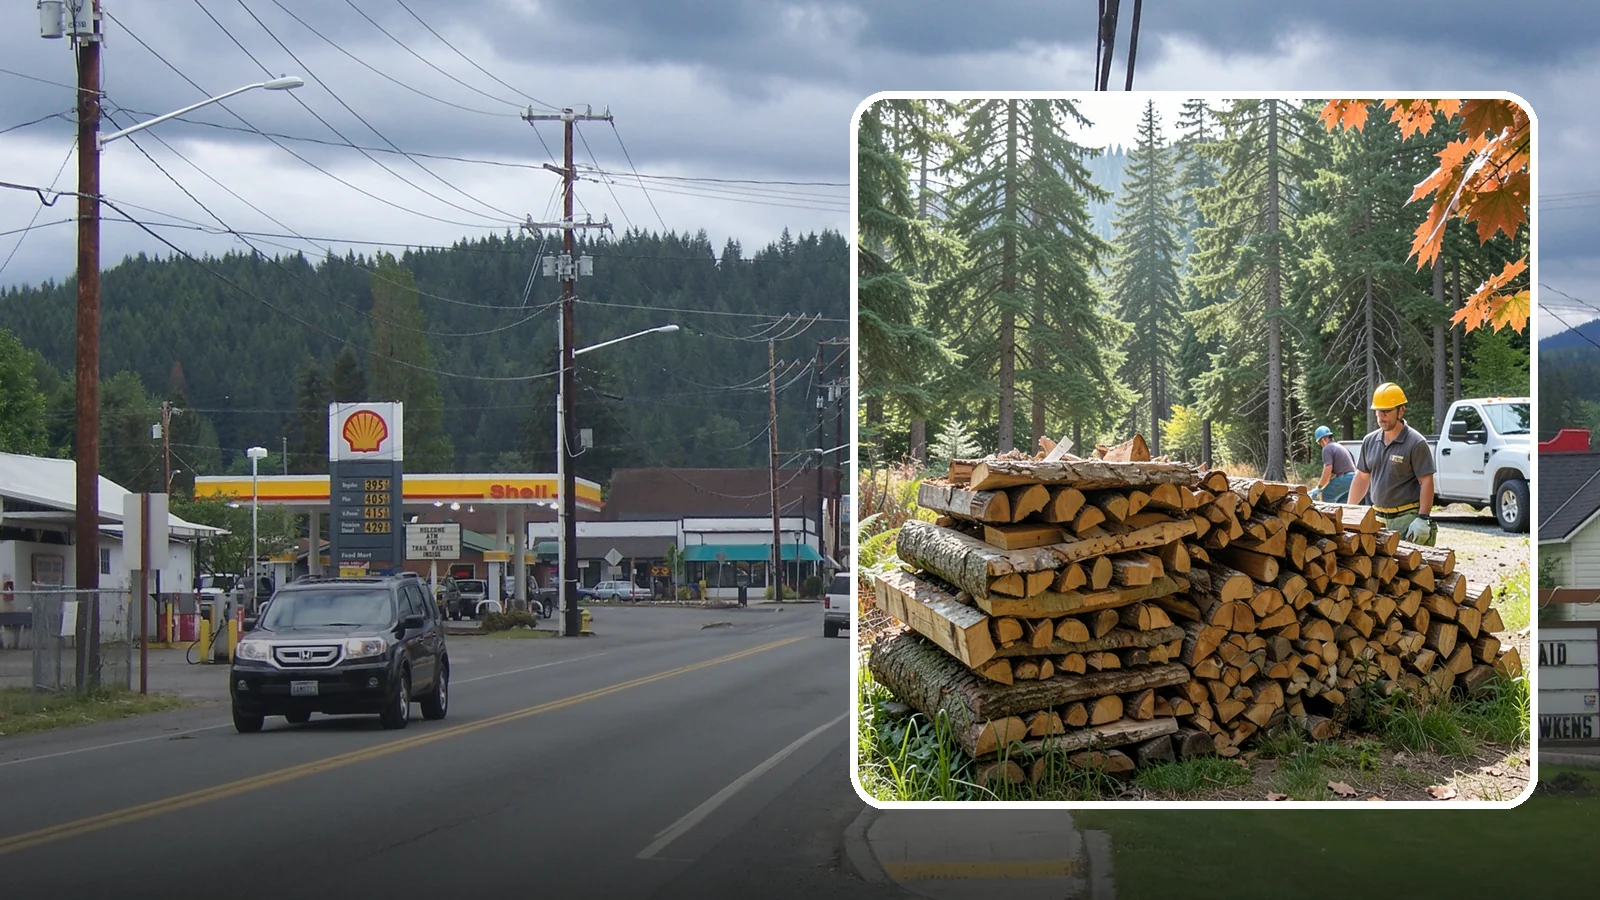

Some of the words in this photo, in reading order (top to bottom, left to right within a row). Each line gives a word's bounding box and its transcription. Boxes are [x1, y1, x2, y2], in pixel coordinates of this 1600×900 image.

[366, 480, 384, 490] 395
[489, 484, 547, 499] Shell
[366, 494, 384, 504] 405
[366, 508, 384, 517] 415
[366, 522, 384, 532] 429
